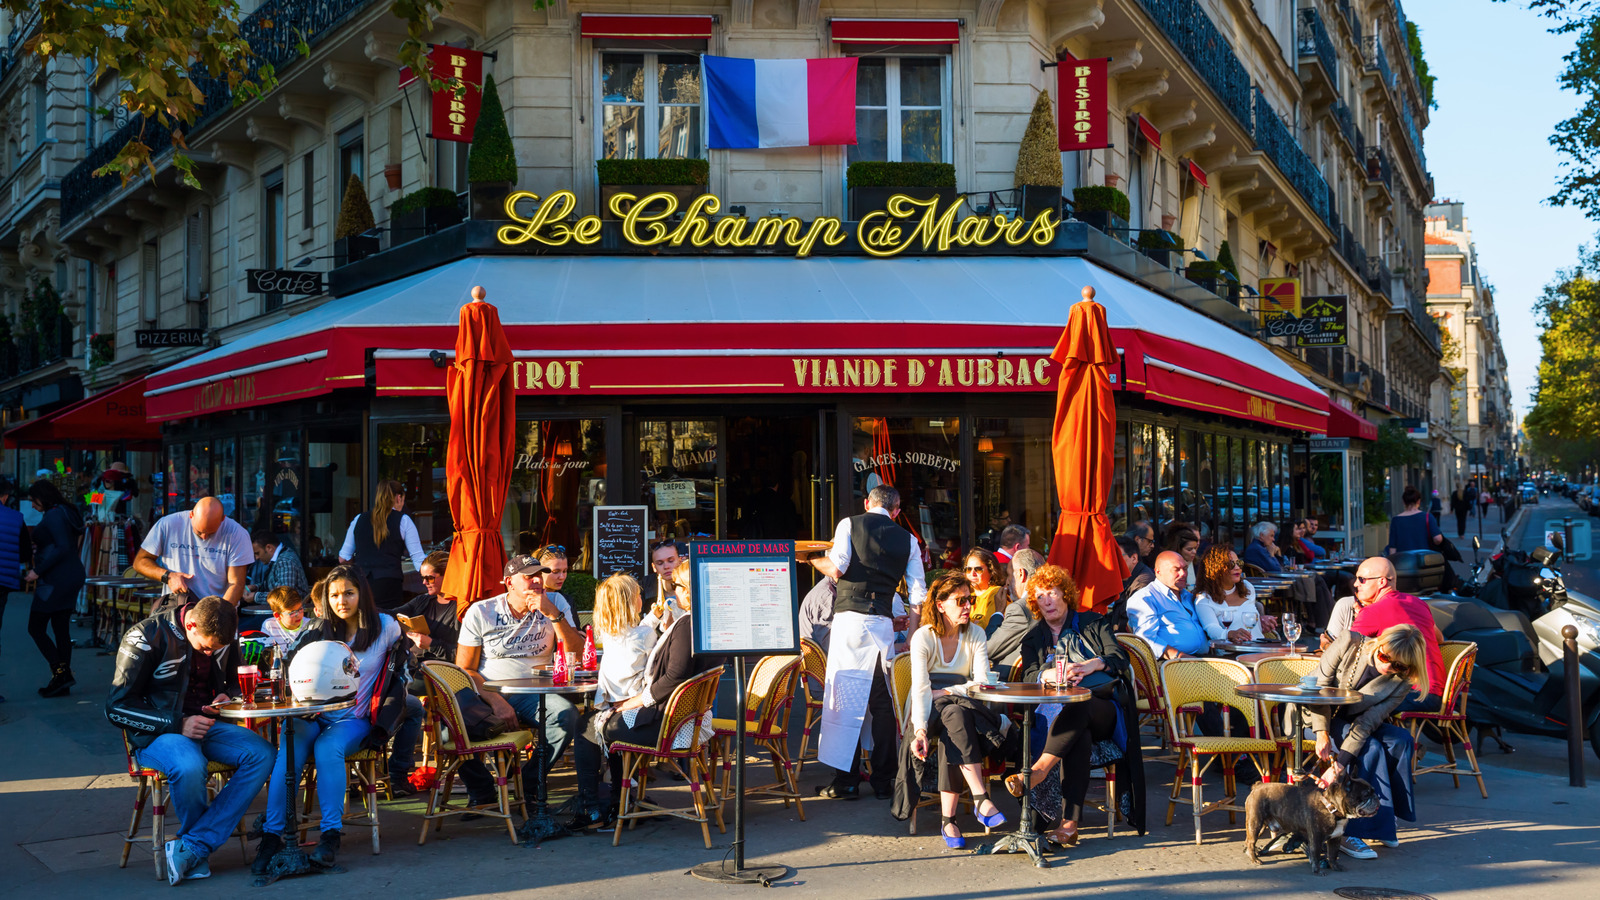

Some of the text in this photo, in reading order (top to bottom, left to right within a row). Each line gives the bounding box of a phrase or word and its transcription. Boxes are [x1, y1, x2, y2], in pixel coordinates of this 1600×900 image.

[1073, 66, 1091, 143] BISTROT
[497, 190, 1061, 258] Le Champ de Mars
[253, 270, 319, 293] Café
[1266, 318, 1316, 336] Café
[139, 332, 201, 345] PIZZERIA
[514, 360, 584, 390] TROT
[792, 358, 1051, 387] VIANDE D'AUBRAC
[106, 401, 146, 417] Past
[1310, 440, 1345, 448] AURANT
[514, 453, 550, 470] Plats
[556, 457, 590, 477] jour
[643, 449, 717, 478] LE CHAMP
[853, 452, 897, 473] GLACES
[905, 451, 957, 473] SORBETS
[170, 542, 200, 551] GANT
[697, 543, 790, 555] LE CHAMP DE MARS
